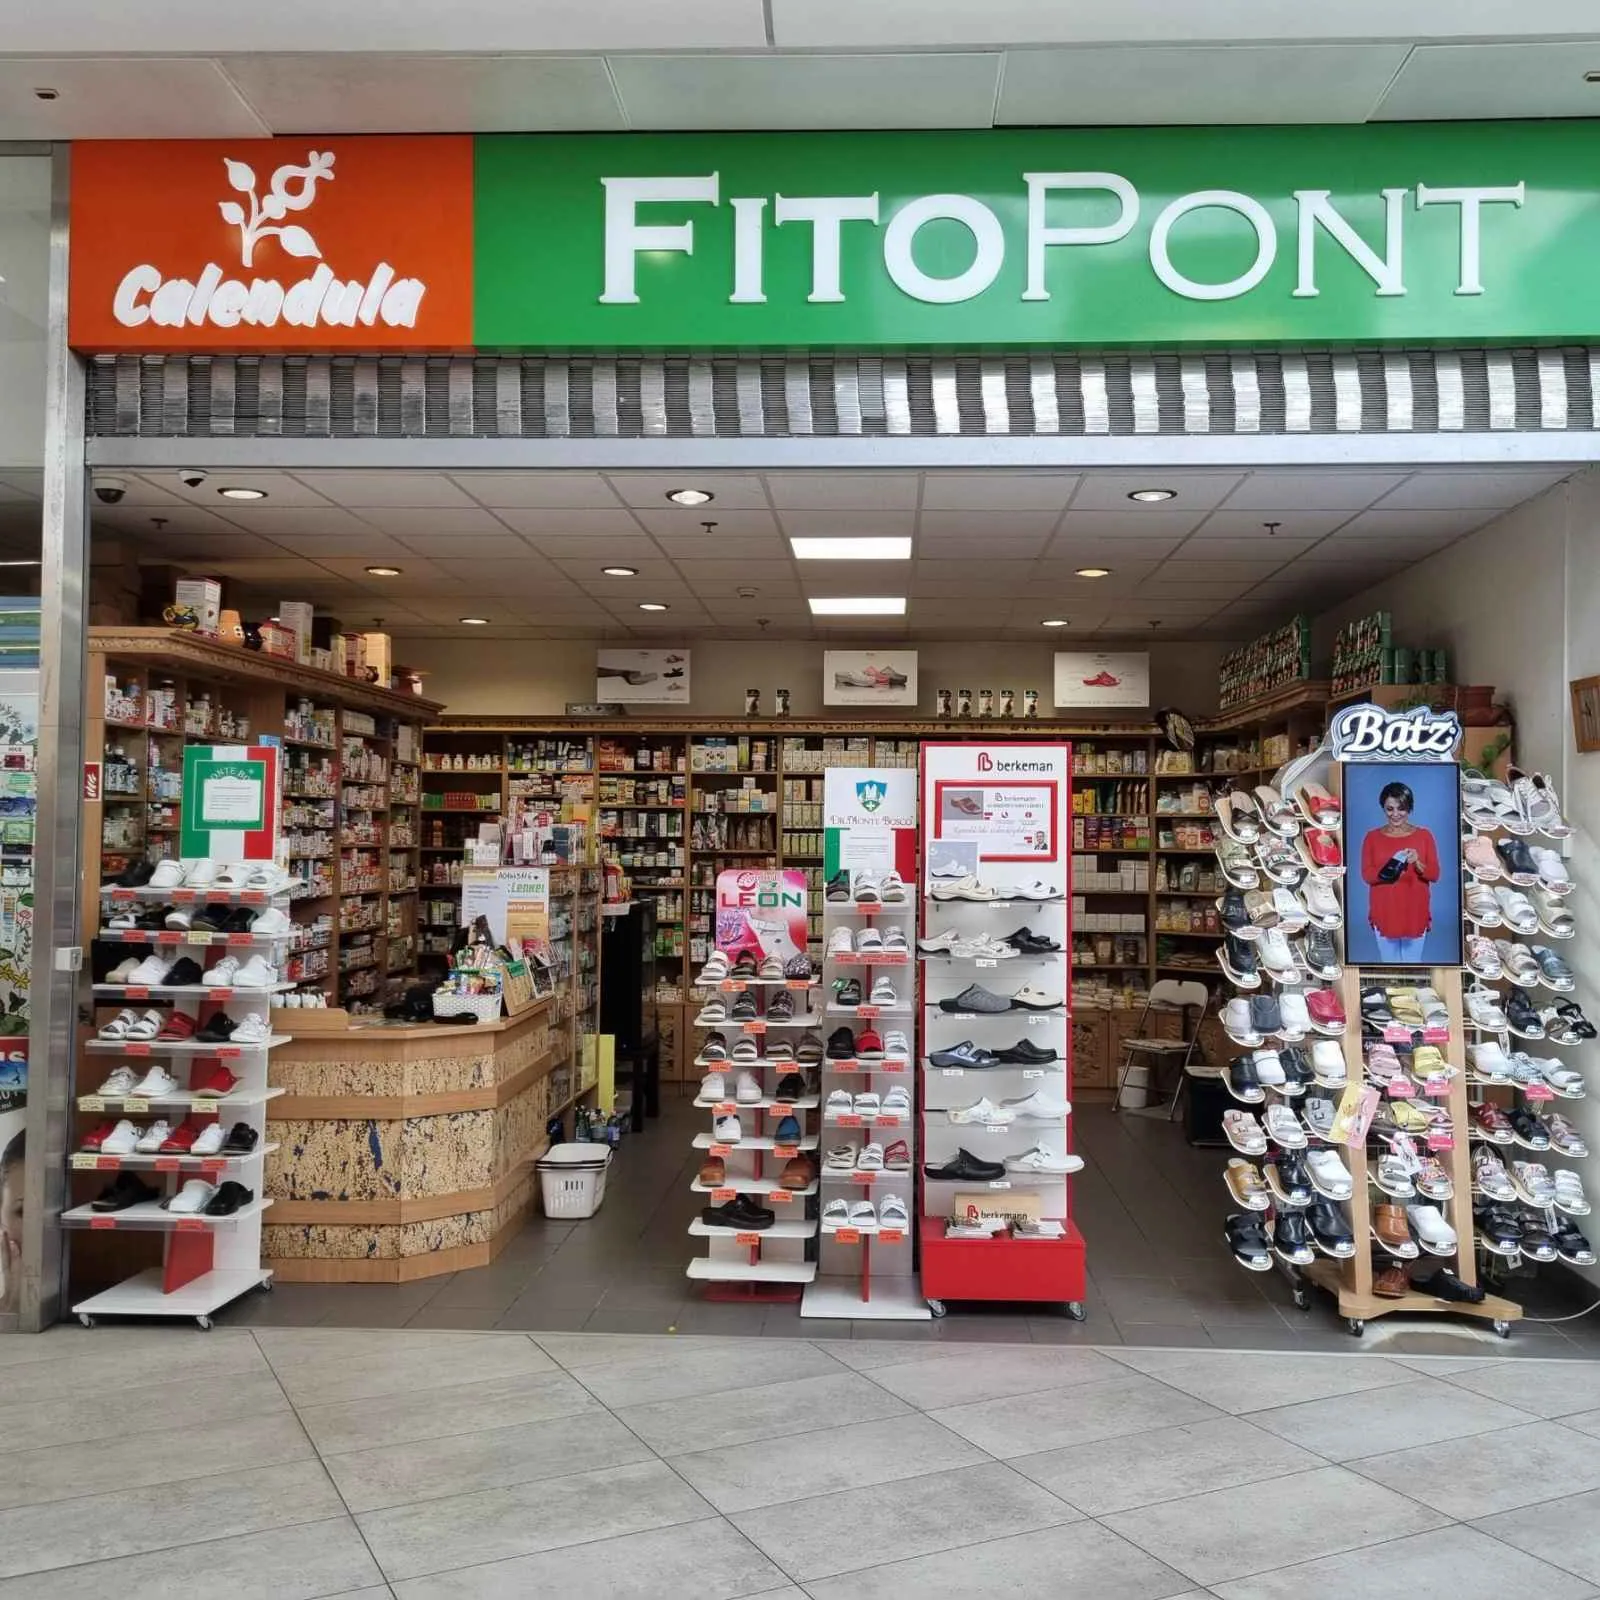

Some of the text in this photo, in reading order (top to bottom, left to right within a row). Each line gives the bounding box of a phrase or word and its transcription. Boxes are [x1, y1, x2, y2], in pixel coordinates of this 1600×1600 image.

[112, 262, 426, 328] Calendula
[1341, 711, 1456, 752] Batz
[721, 892, 802, 908] LEON
